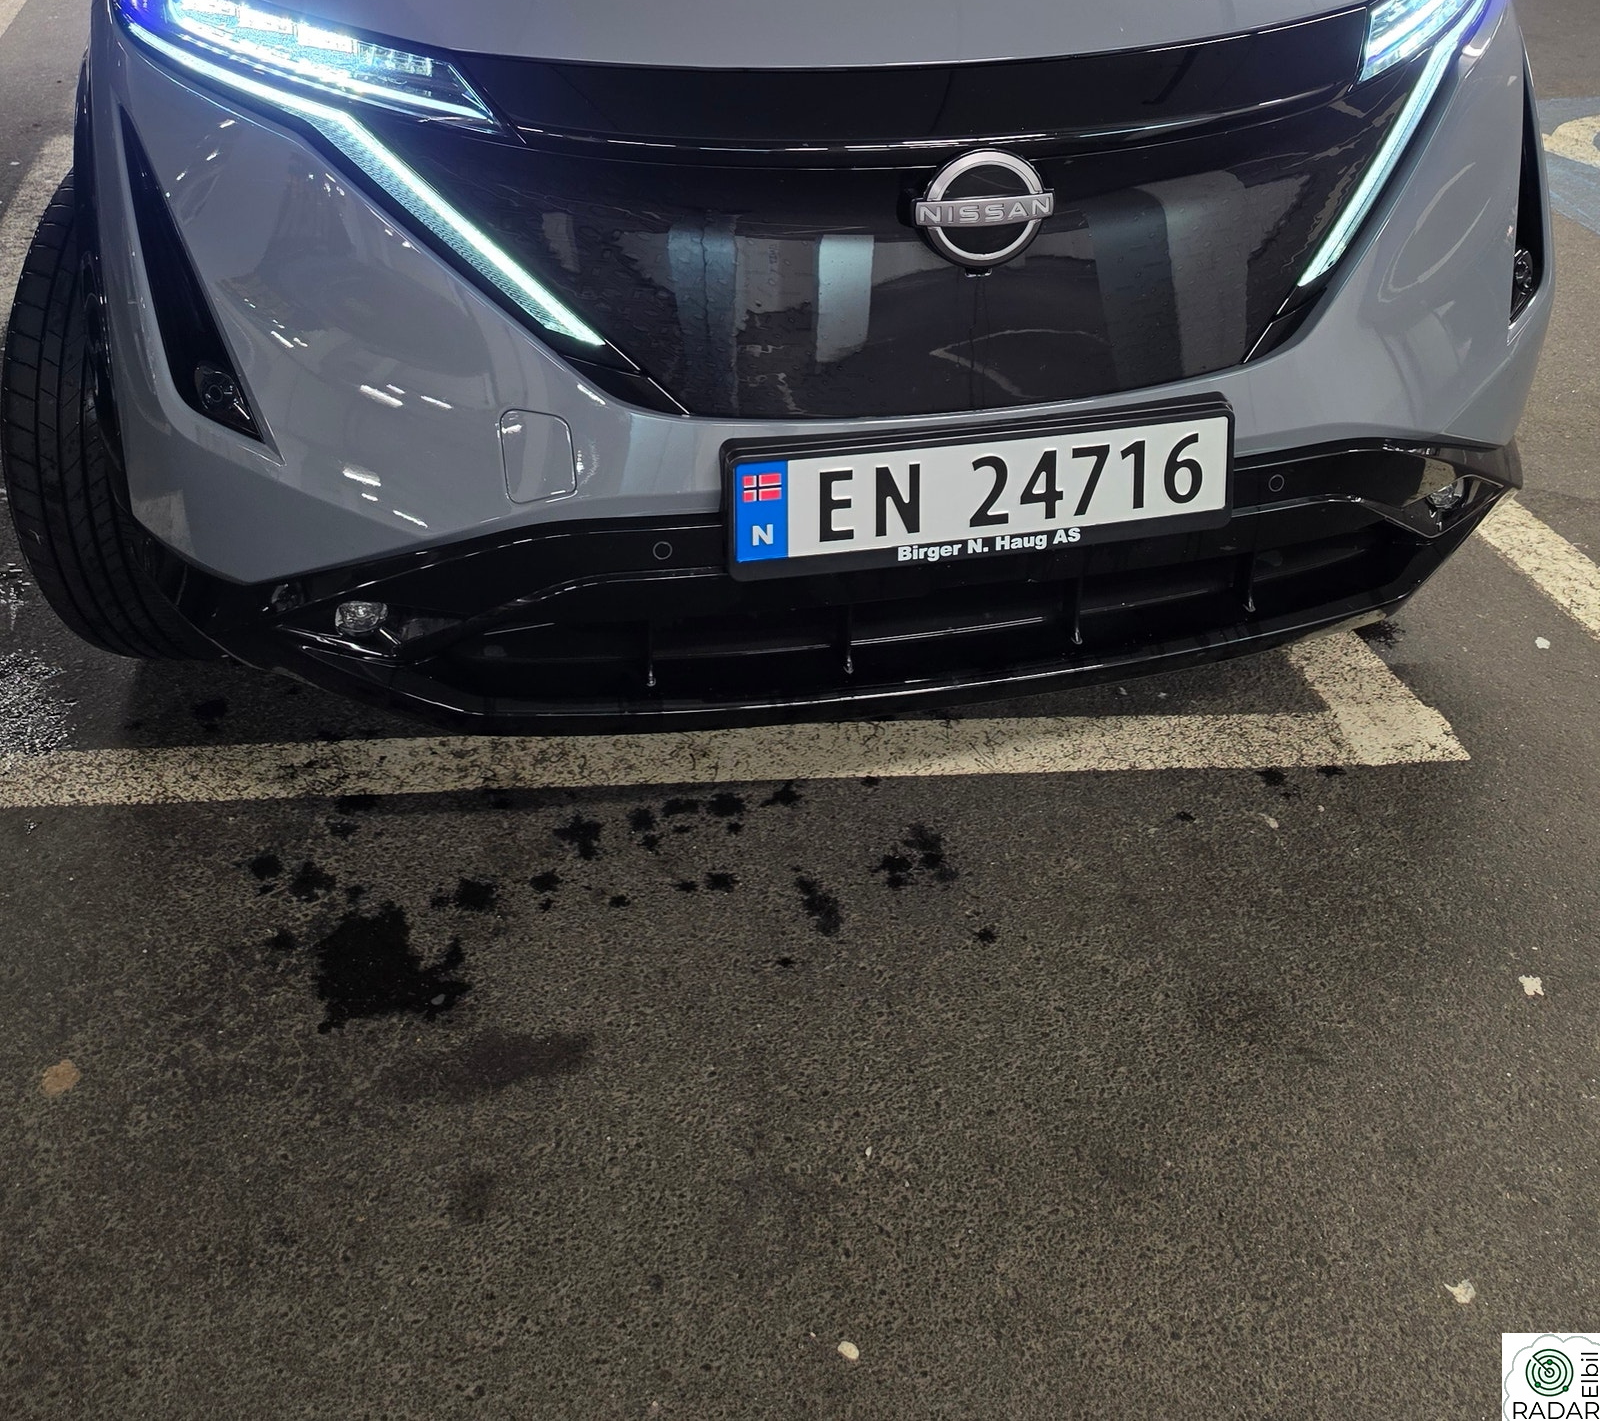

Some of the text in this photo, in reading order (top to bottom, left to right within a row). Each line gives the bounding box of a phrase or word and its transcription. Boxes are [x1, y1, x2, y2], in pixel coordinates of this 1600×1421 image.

[919, 196, 1051, 225] NISSAN
[818, 432, 1202, 543] EN 24716
[751, 523, 774, 546] N
[897, 527, 1081, 562] Birger N. Haug AS
